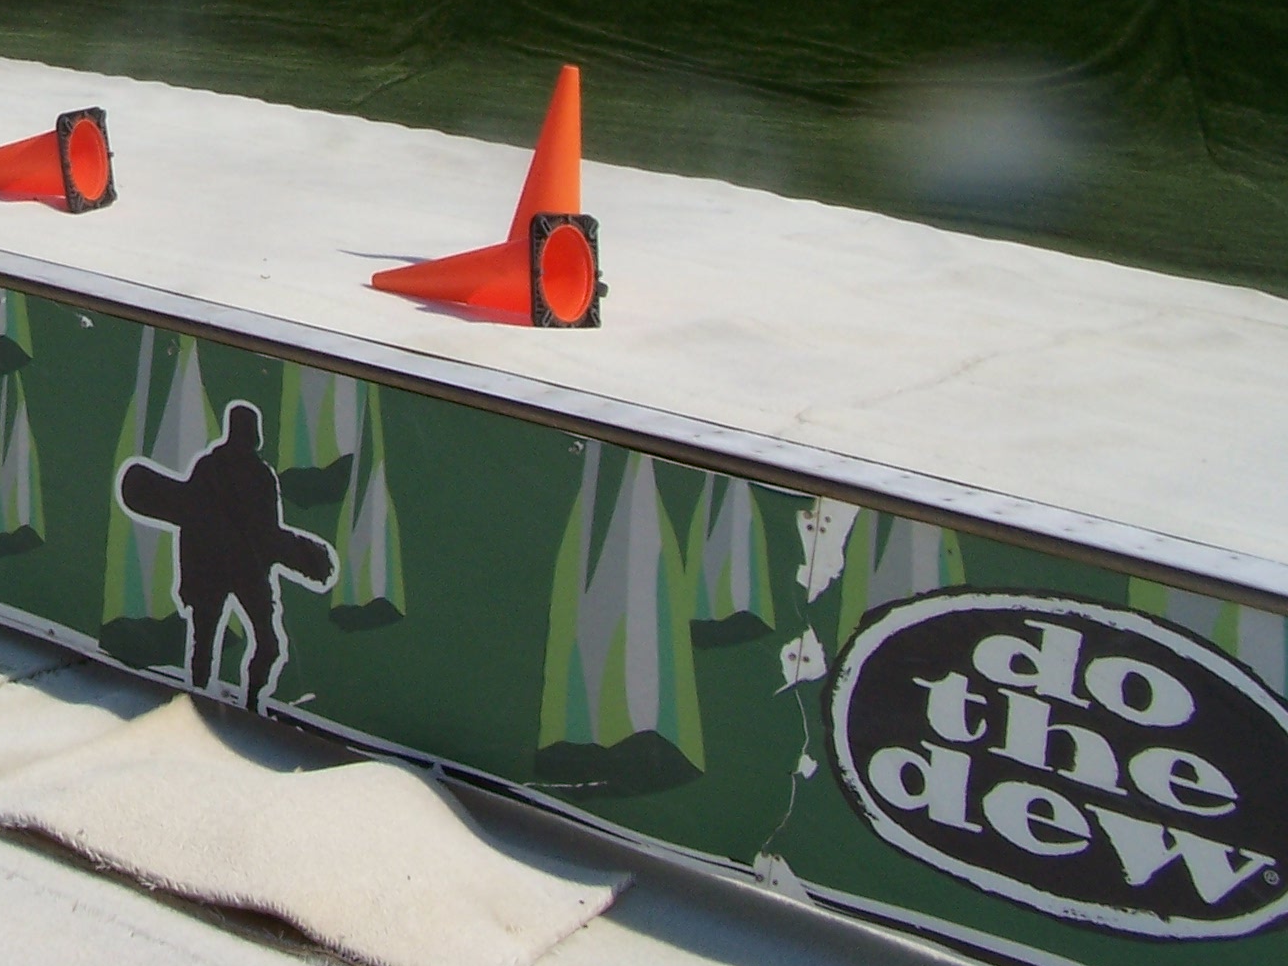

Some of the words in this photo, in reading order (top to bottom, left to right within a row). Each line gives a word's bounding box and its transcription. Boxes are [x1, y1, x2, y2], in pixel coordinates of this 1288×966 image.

[913, 671, 1239, 816] the
[973, 620, 1196, 727] do
[868, 741, 1276, 905] dew
